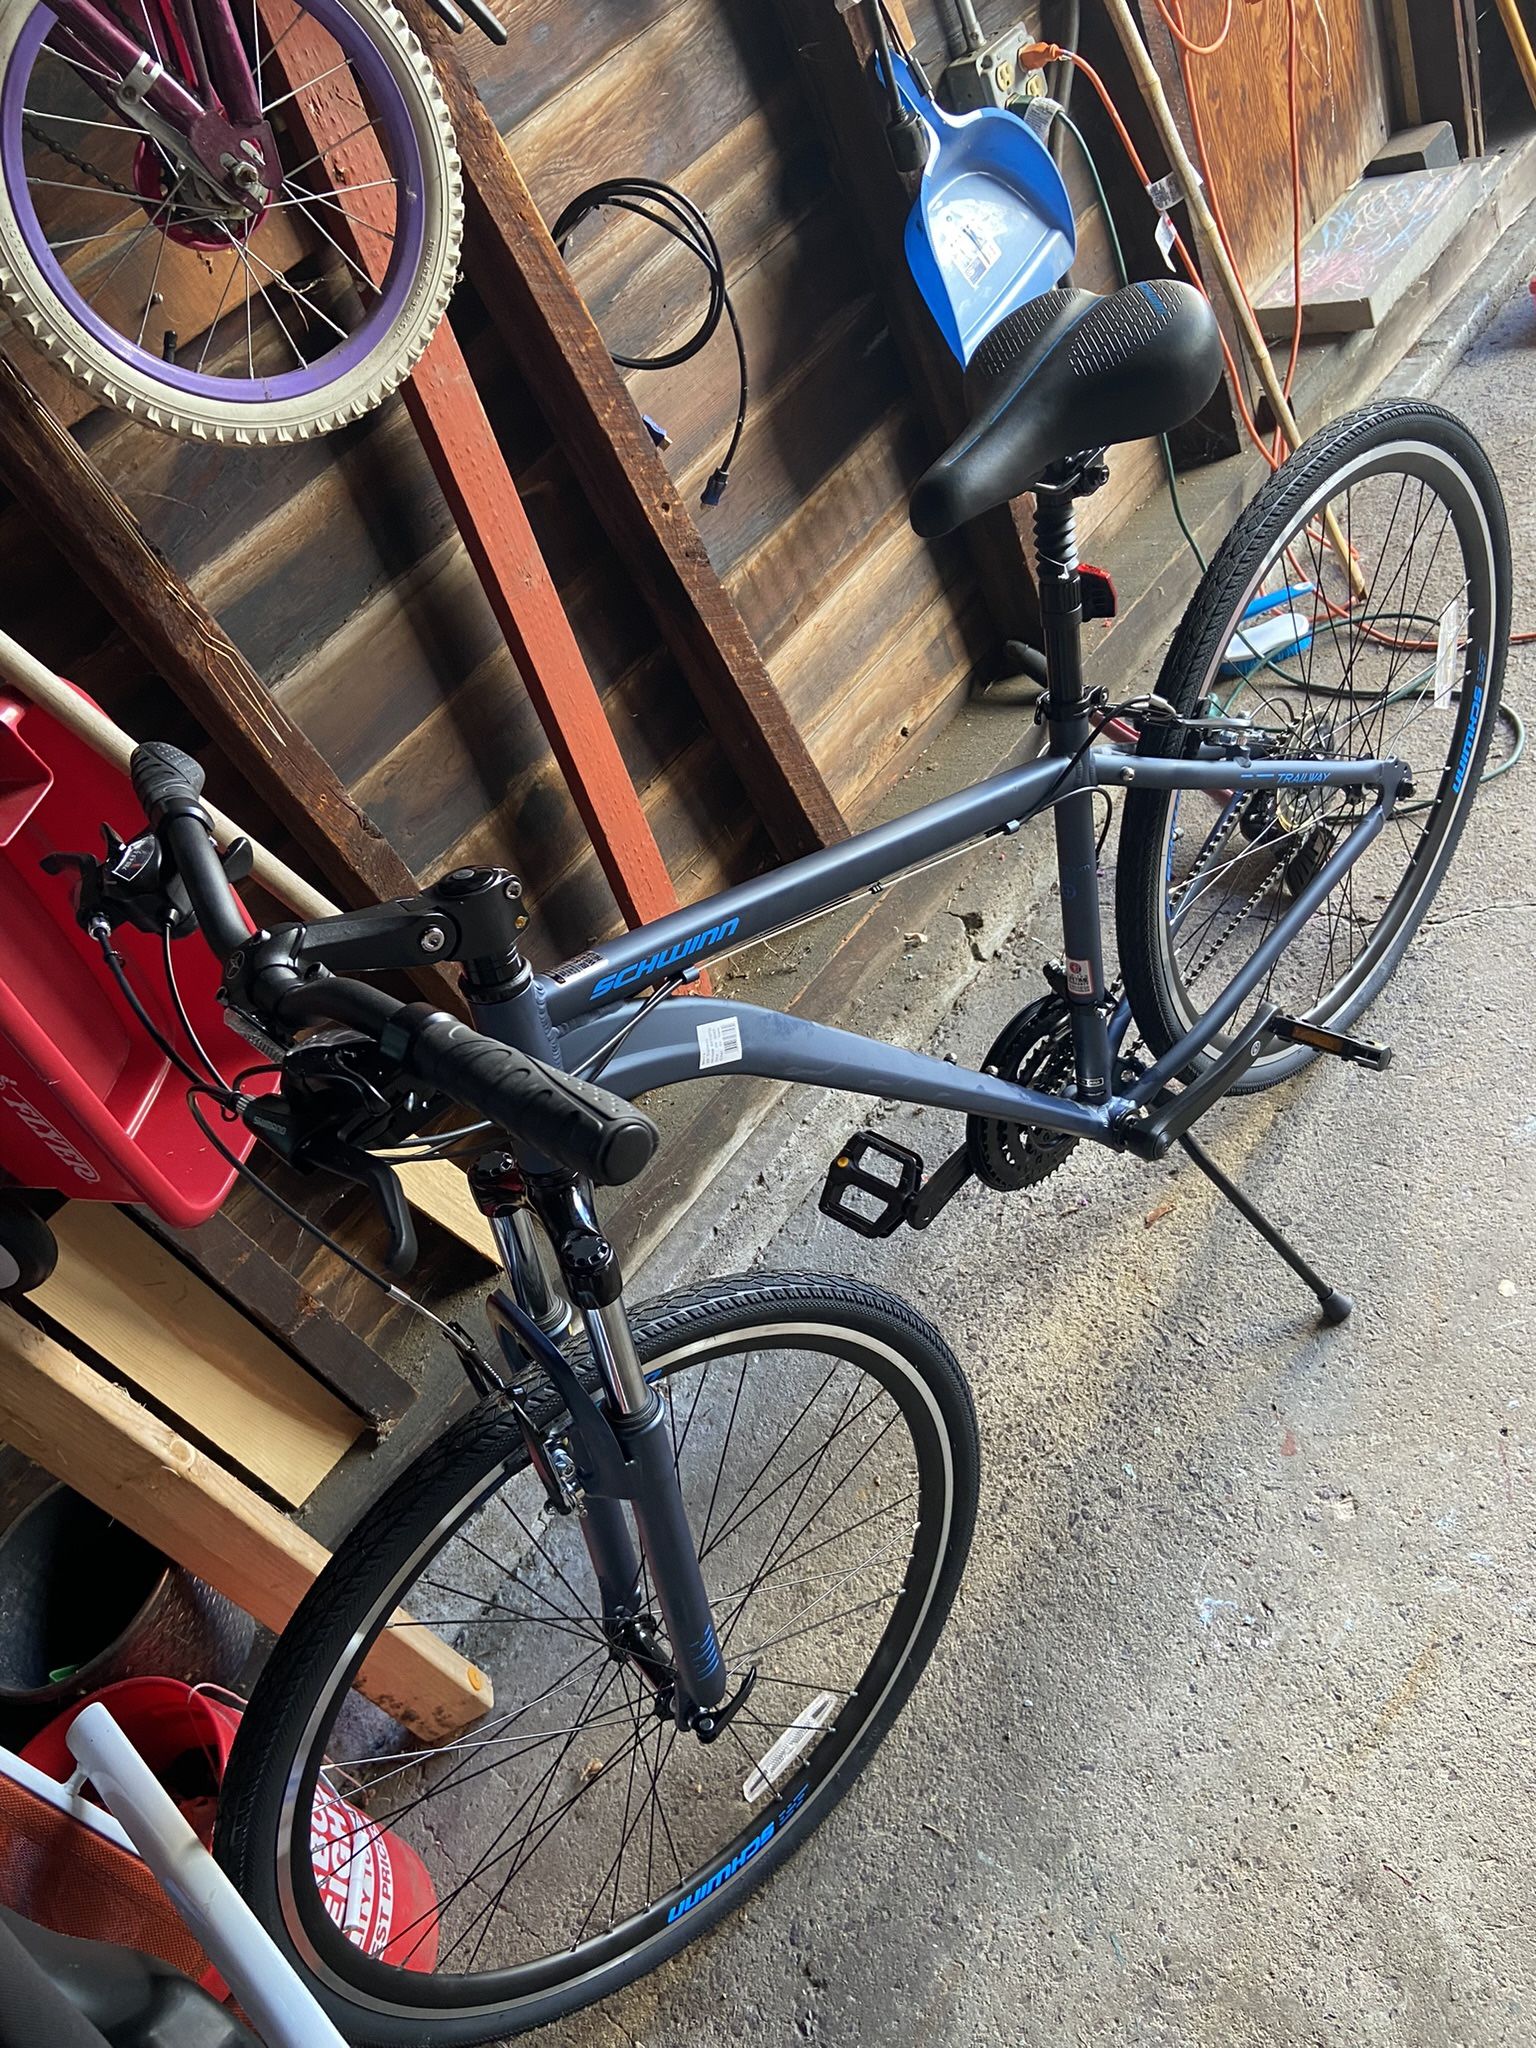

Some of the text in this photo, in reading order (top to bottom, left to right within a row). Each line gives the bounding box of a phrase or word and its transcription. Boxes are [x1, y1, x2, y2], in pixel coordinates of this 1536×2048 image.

[1277, 772, 1331, 784] TRAILWAY
[1452, 685, 1482, 794] SCHWINN
[590, 916, 740, 1000] SCHWINN
[2, 1097, 99, 1182] FLYER
[667, 1821, 775, 1924] SCHWINN
